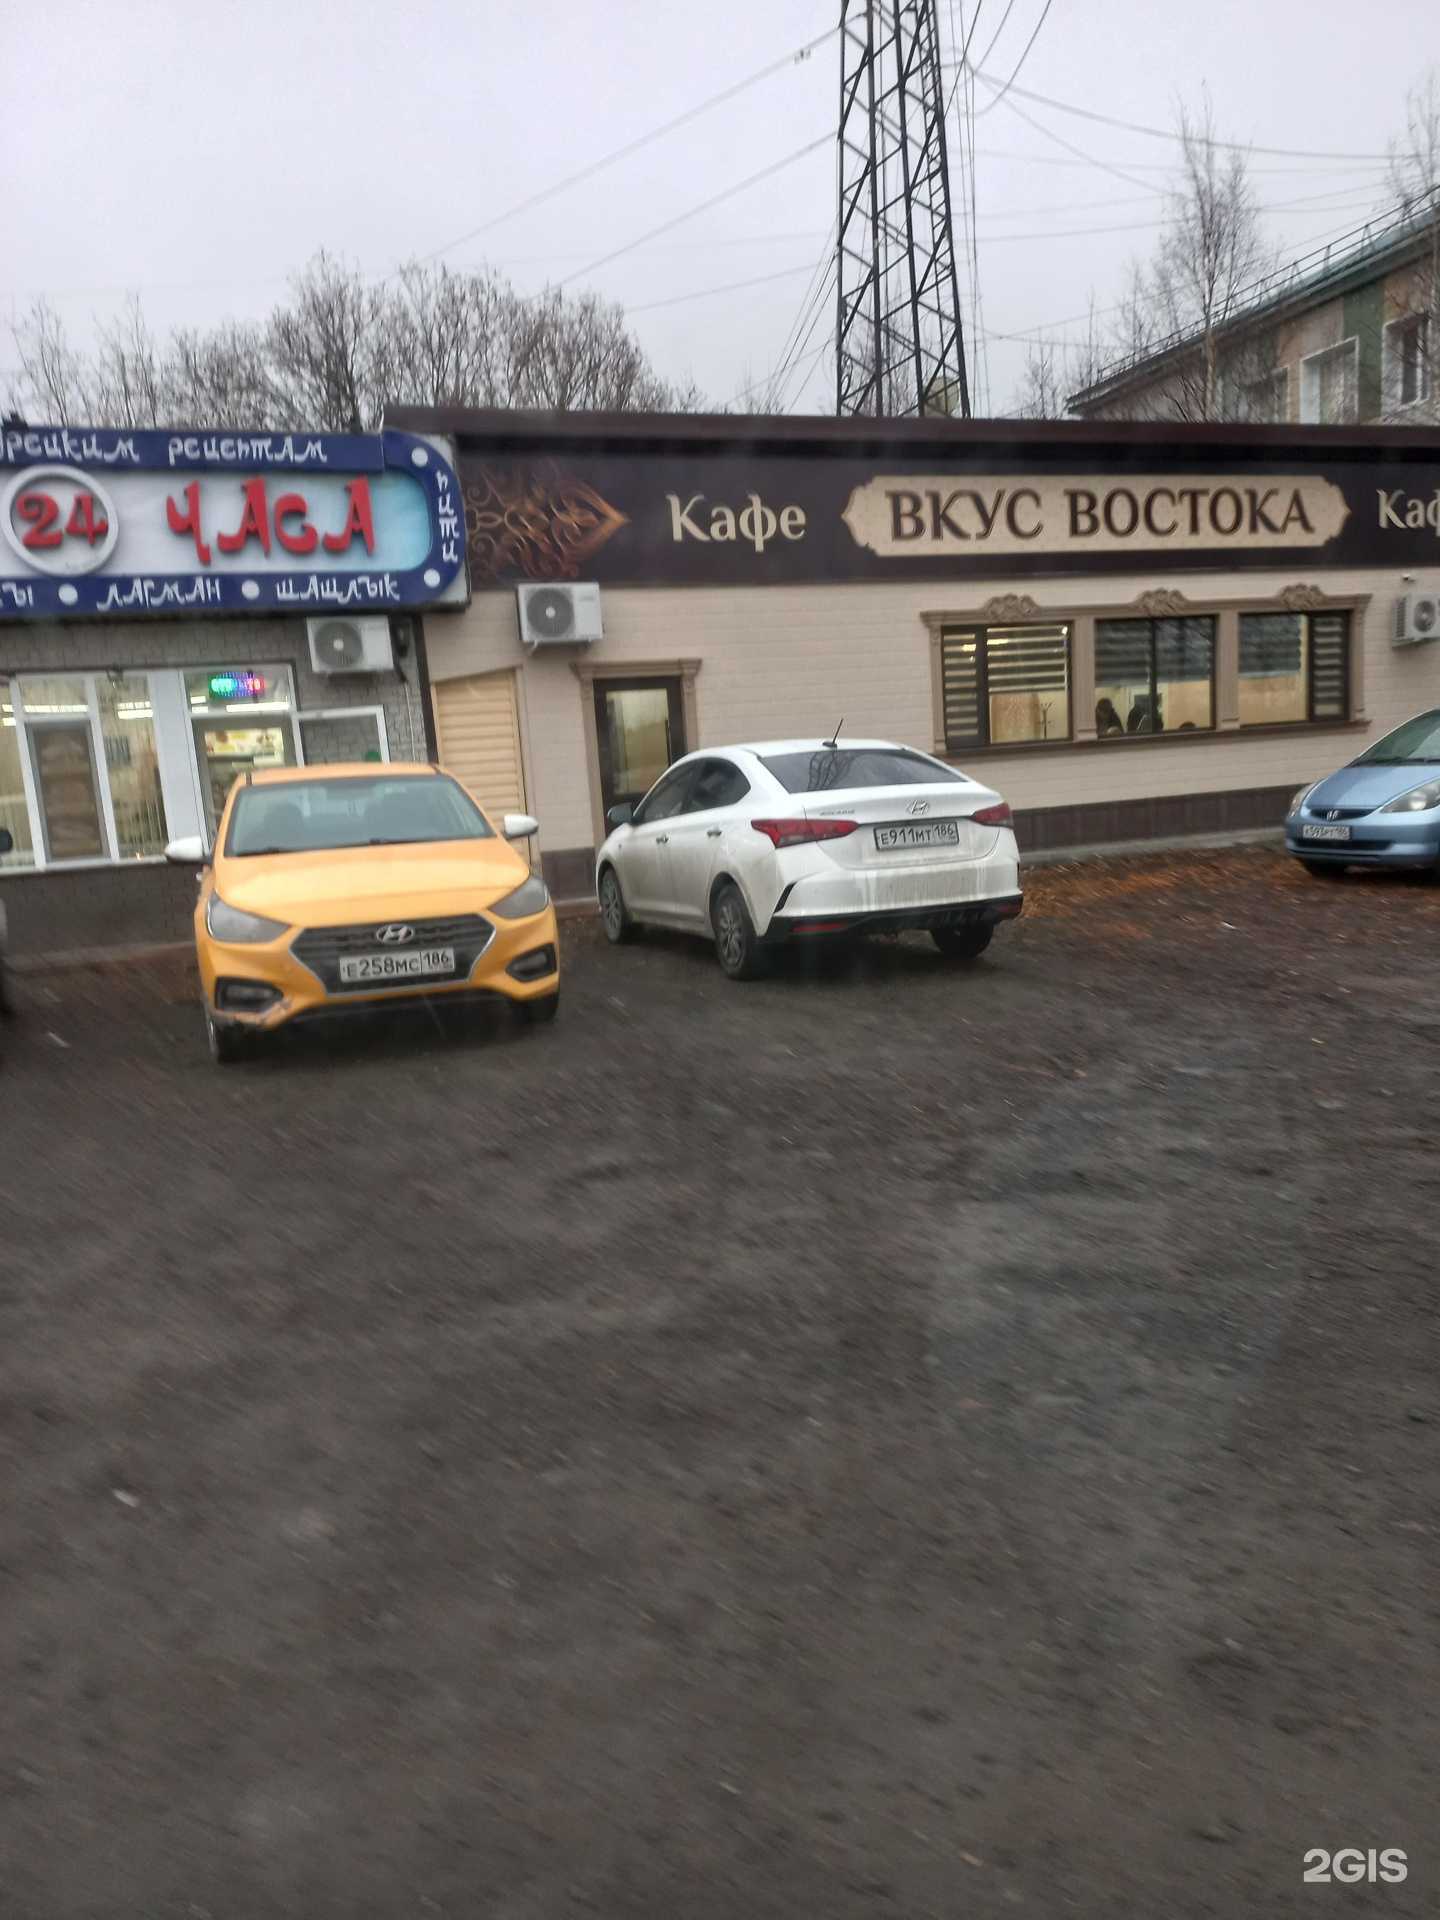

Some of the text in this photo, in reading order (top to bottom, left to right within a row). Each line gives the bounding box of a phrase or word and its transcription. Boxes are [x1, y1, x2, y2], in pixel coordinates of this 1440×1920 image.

[16, 475, 375, 565] 24 ЧАСА
[666, 492, 806, 552] Кафе
[885, 487, 1316, 542] ВКУС ВОСТОКА
